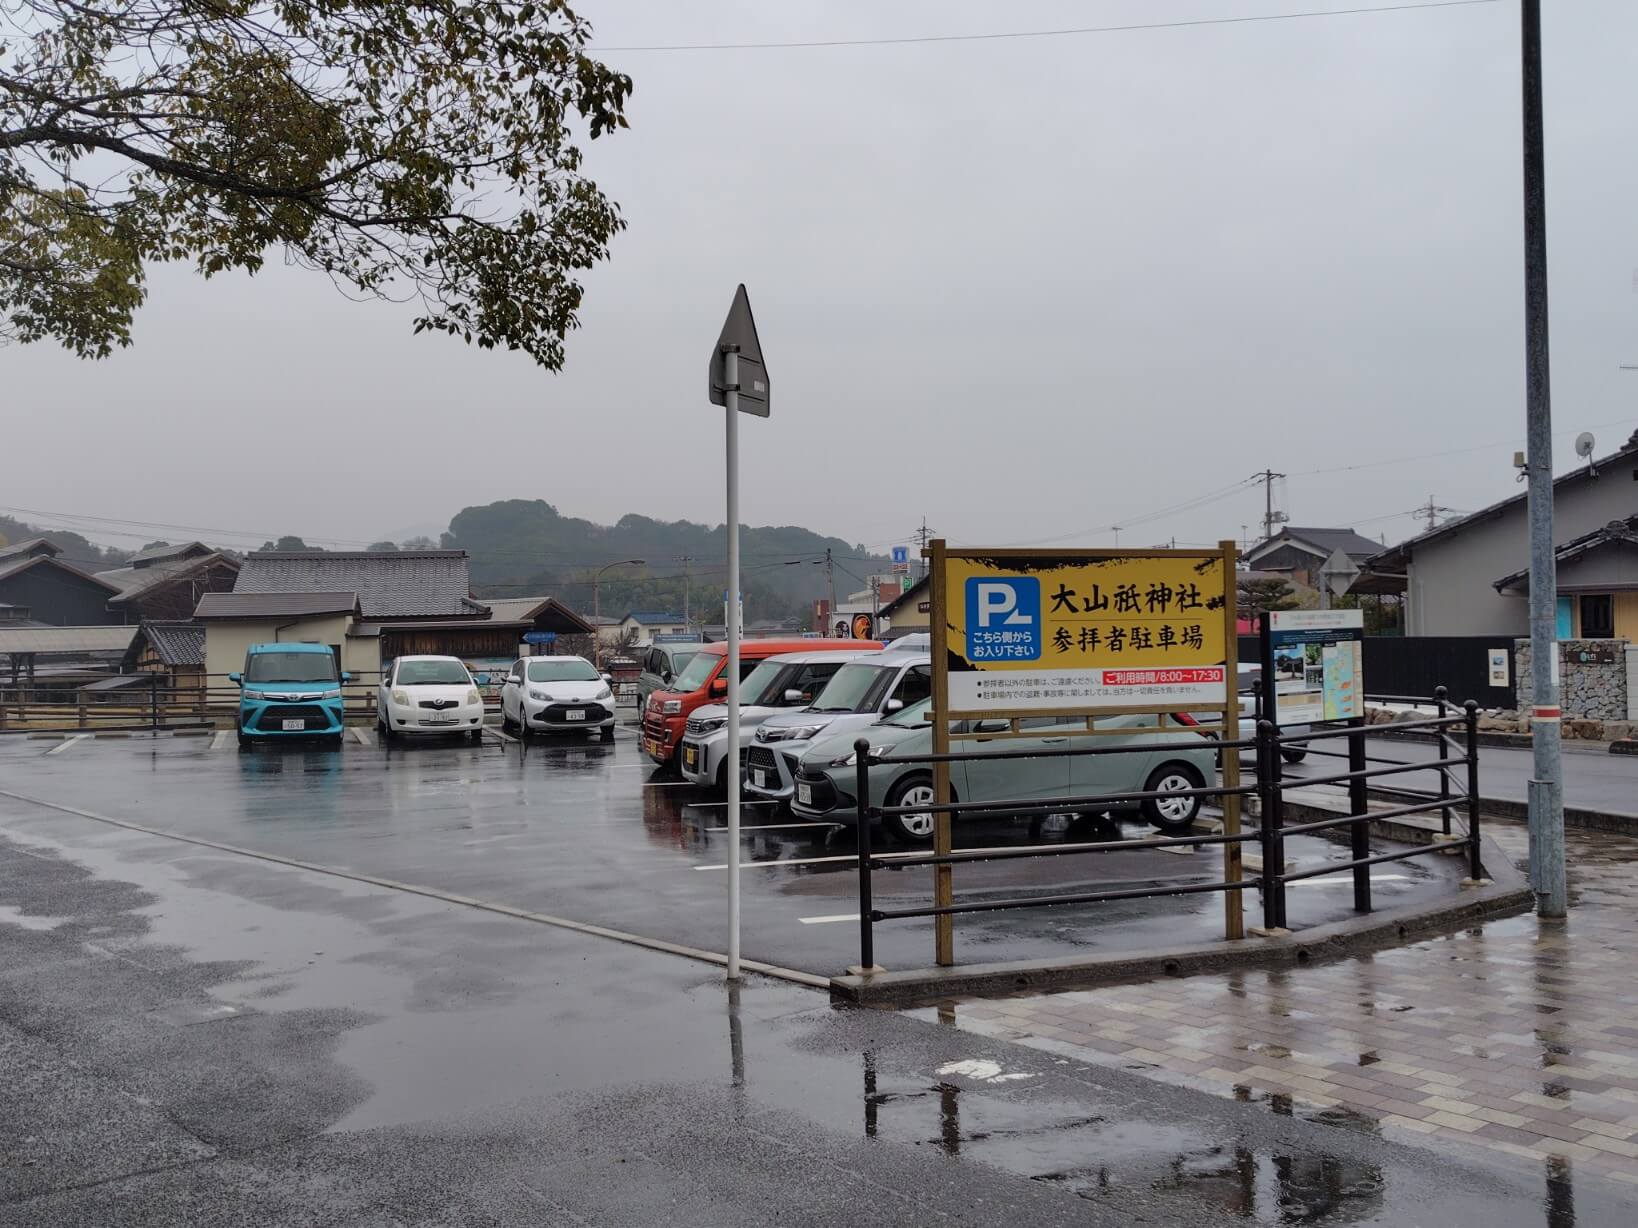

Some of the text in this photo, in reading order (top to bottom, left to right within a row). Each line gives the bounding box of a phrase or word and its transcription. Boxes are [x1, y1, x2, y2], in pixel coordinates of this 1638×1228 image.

[978, 583, 1017, 627] P
[1050, 582, 1203, 614] 大山祇神社
[973, 631, 1032, 644] こちら側から
[973, 645, 1035, 658] お入り下さい
[1051, 623, 1204, 654] 参拝者駐車場
